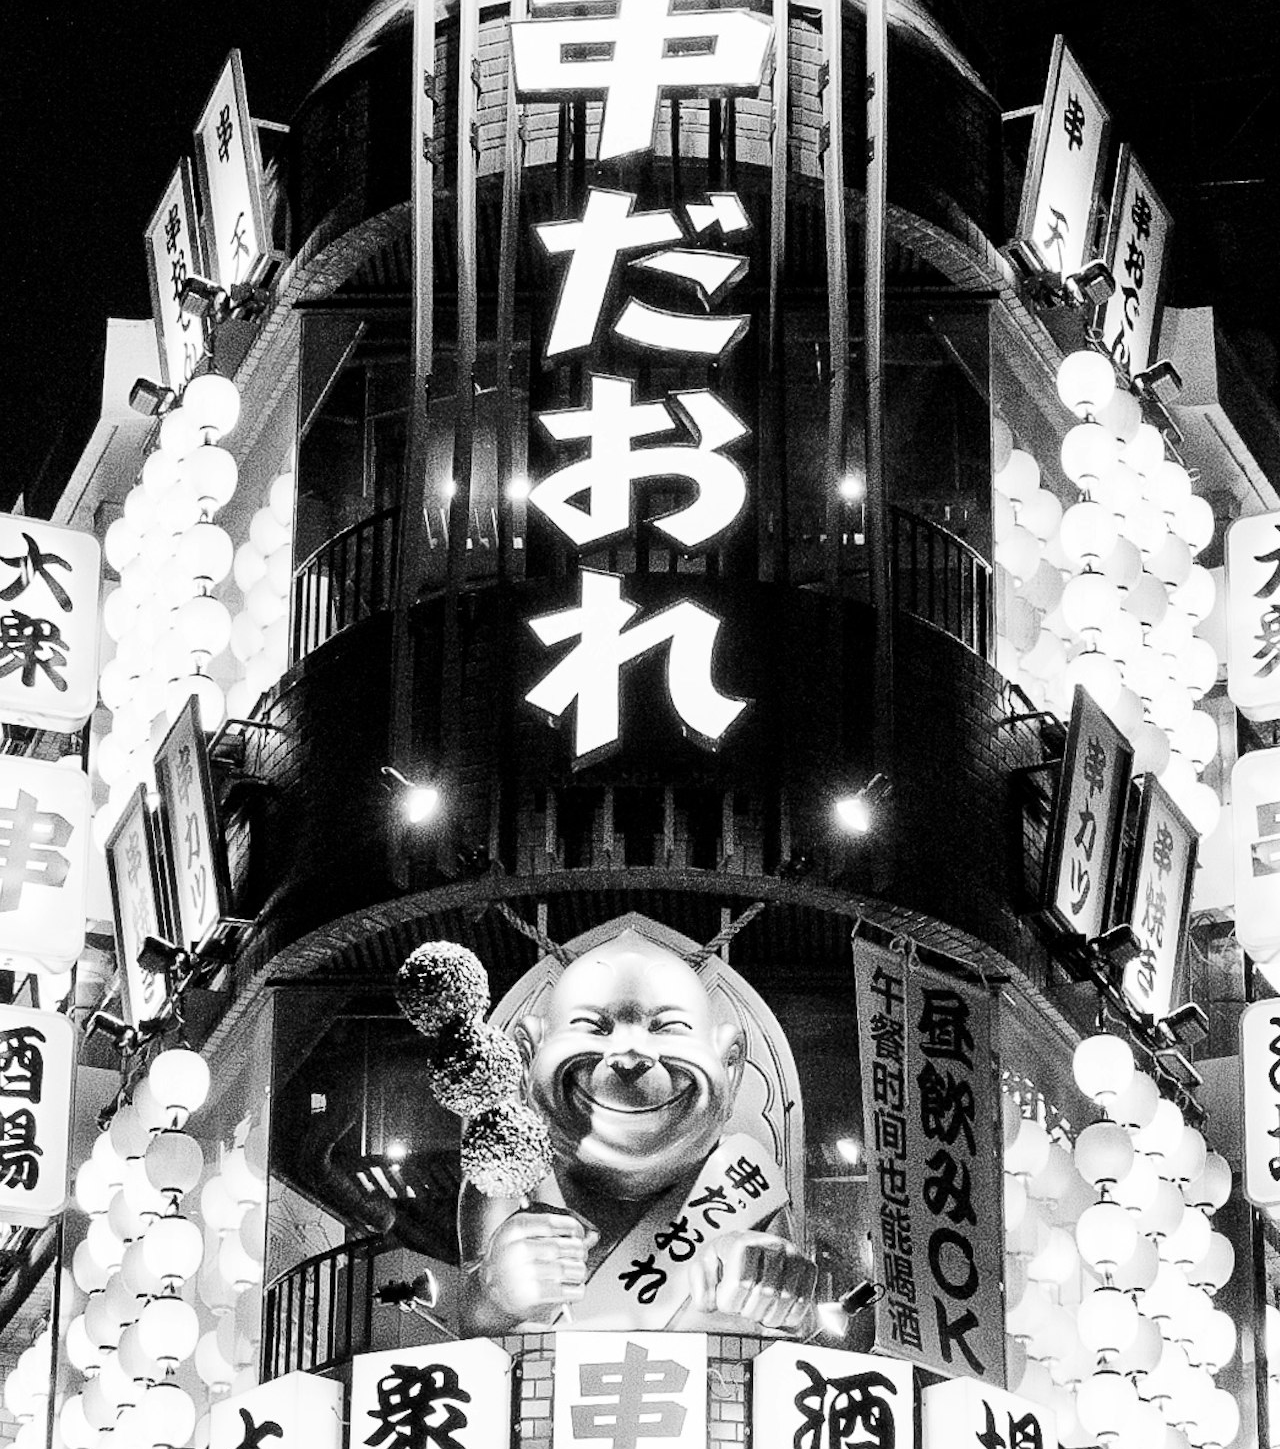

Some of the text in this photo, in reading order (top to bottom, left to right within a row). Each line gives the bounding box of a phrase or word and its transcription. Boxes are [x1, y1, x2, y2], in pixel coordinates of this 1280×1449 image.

[176, 744, 208, 926] 串カツ
[1071, 735, 1107, 916] 串カツ
[617, 1155, 770, 1305] 串だおれ
[917, 987, 986, 1378] 昼飲みOK
